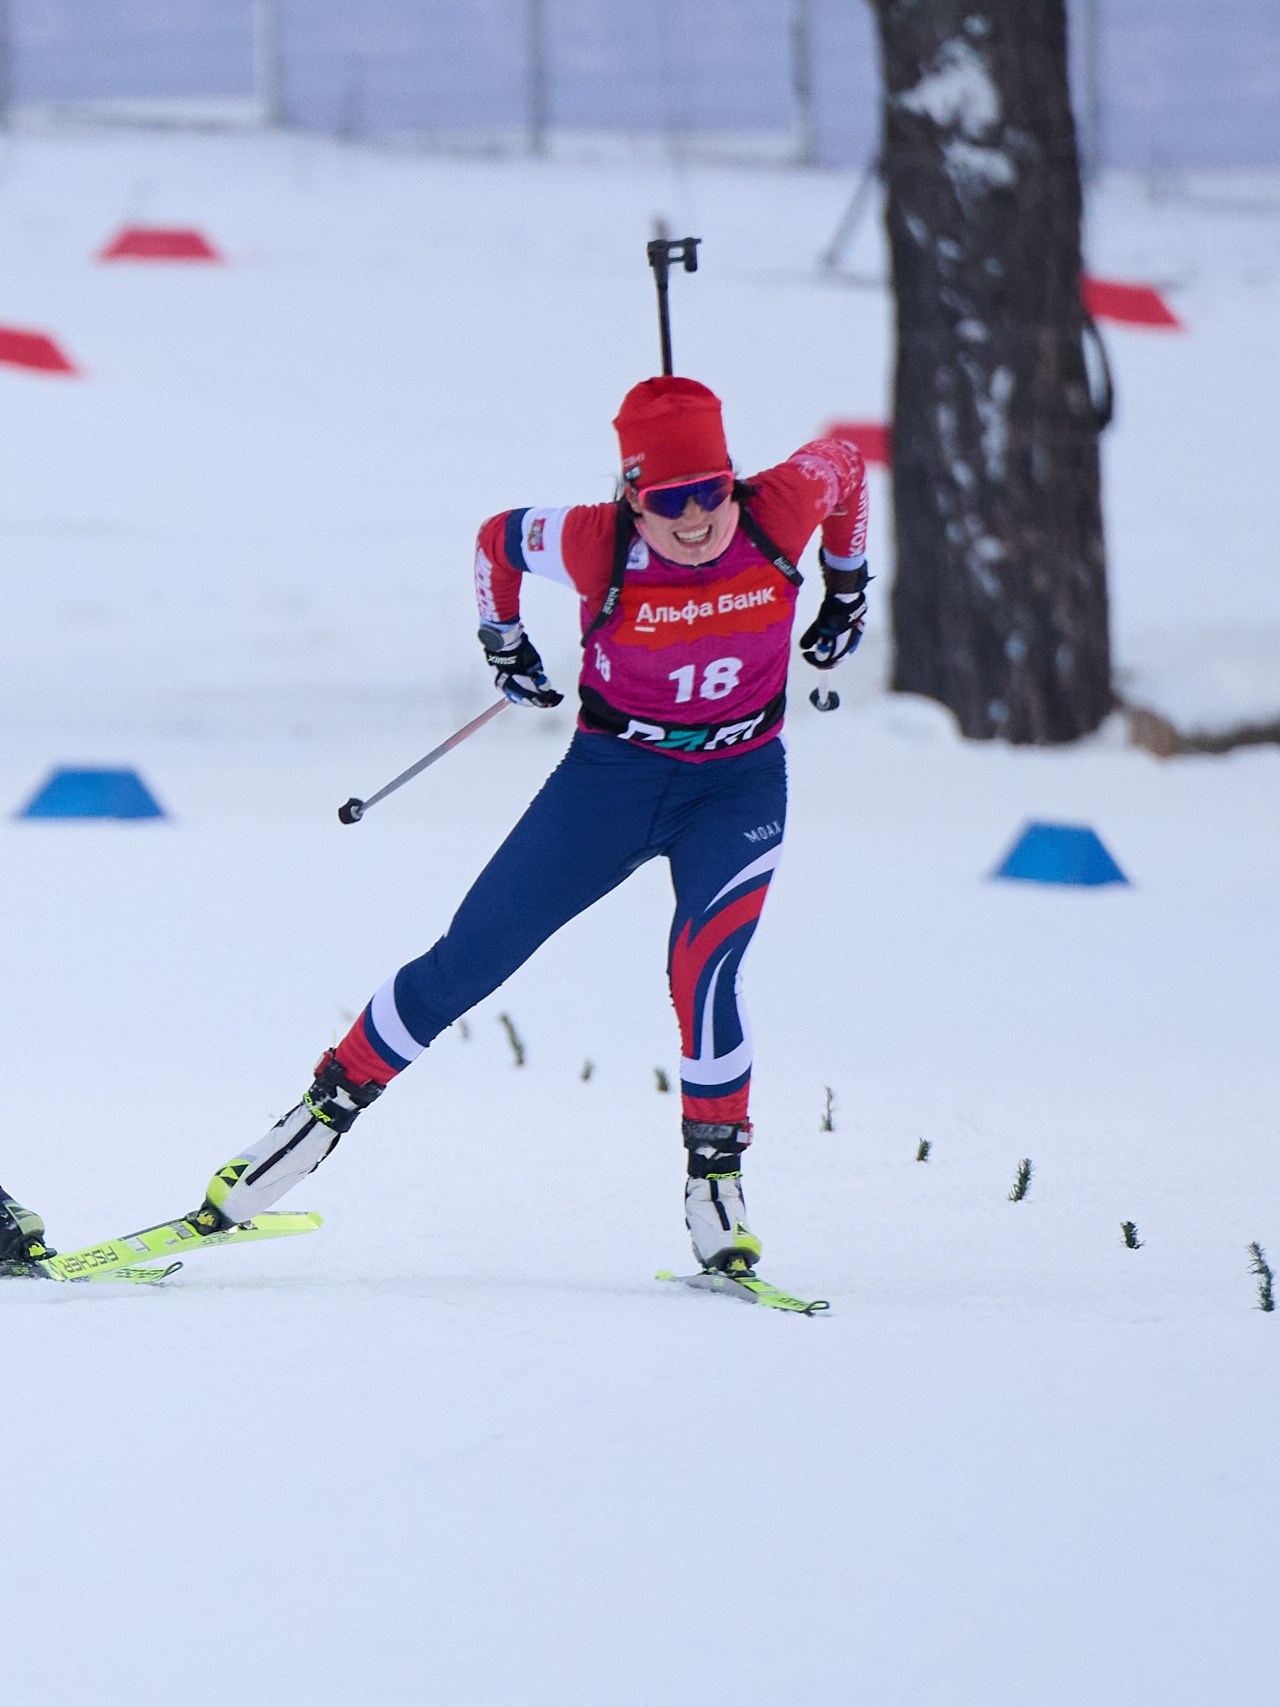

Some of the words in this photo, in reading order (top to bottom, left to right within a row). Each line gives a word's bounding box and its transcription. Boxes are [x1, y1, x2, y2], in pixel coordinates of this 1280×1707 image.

[634, 601, 714, 631] Альфа
[717, 586, 776, 614] Банк
[668, 656, 744, 704] 18
[59, 1245, 119, 1273] FISCHER
